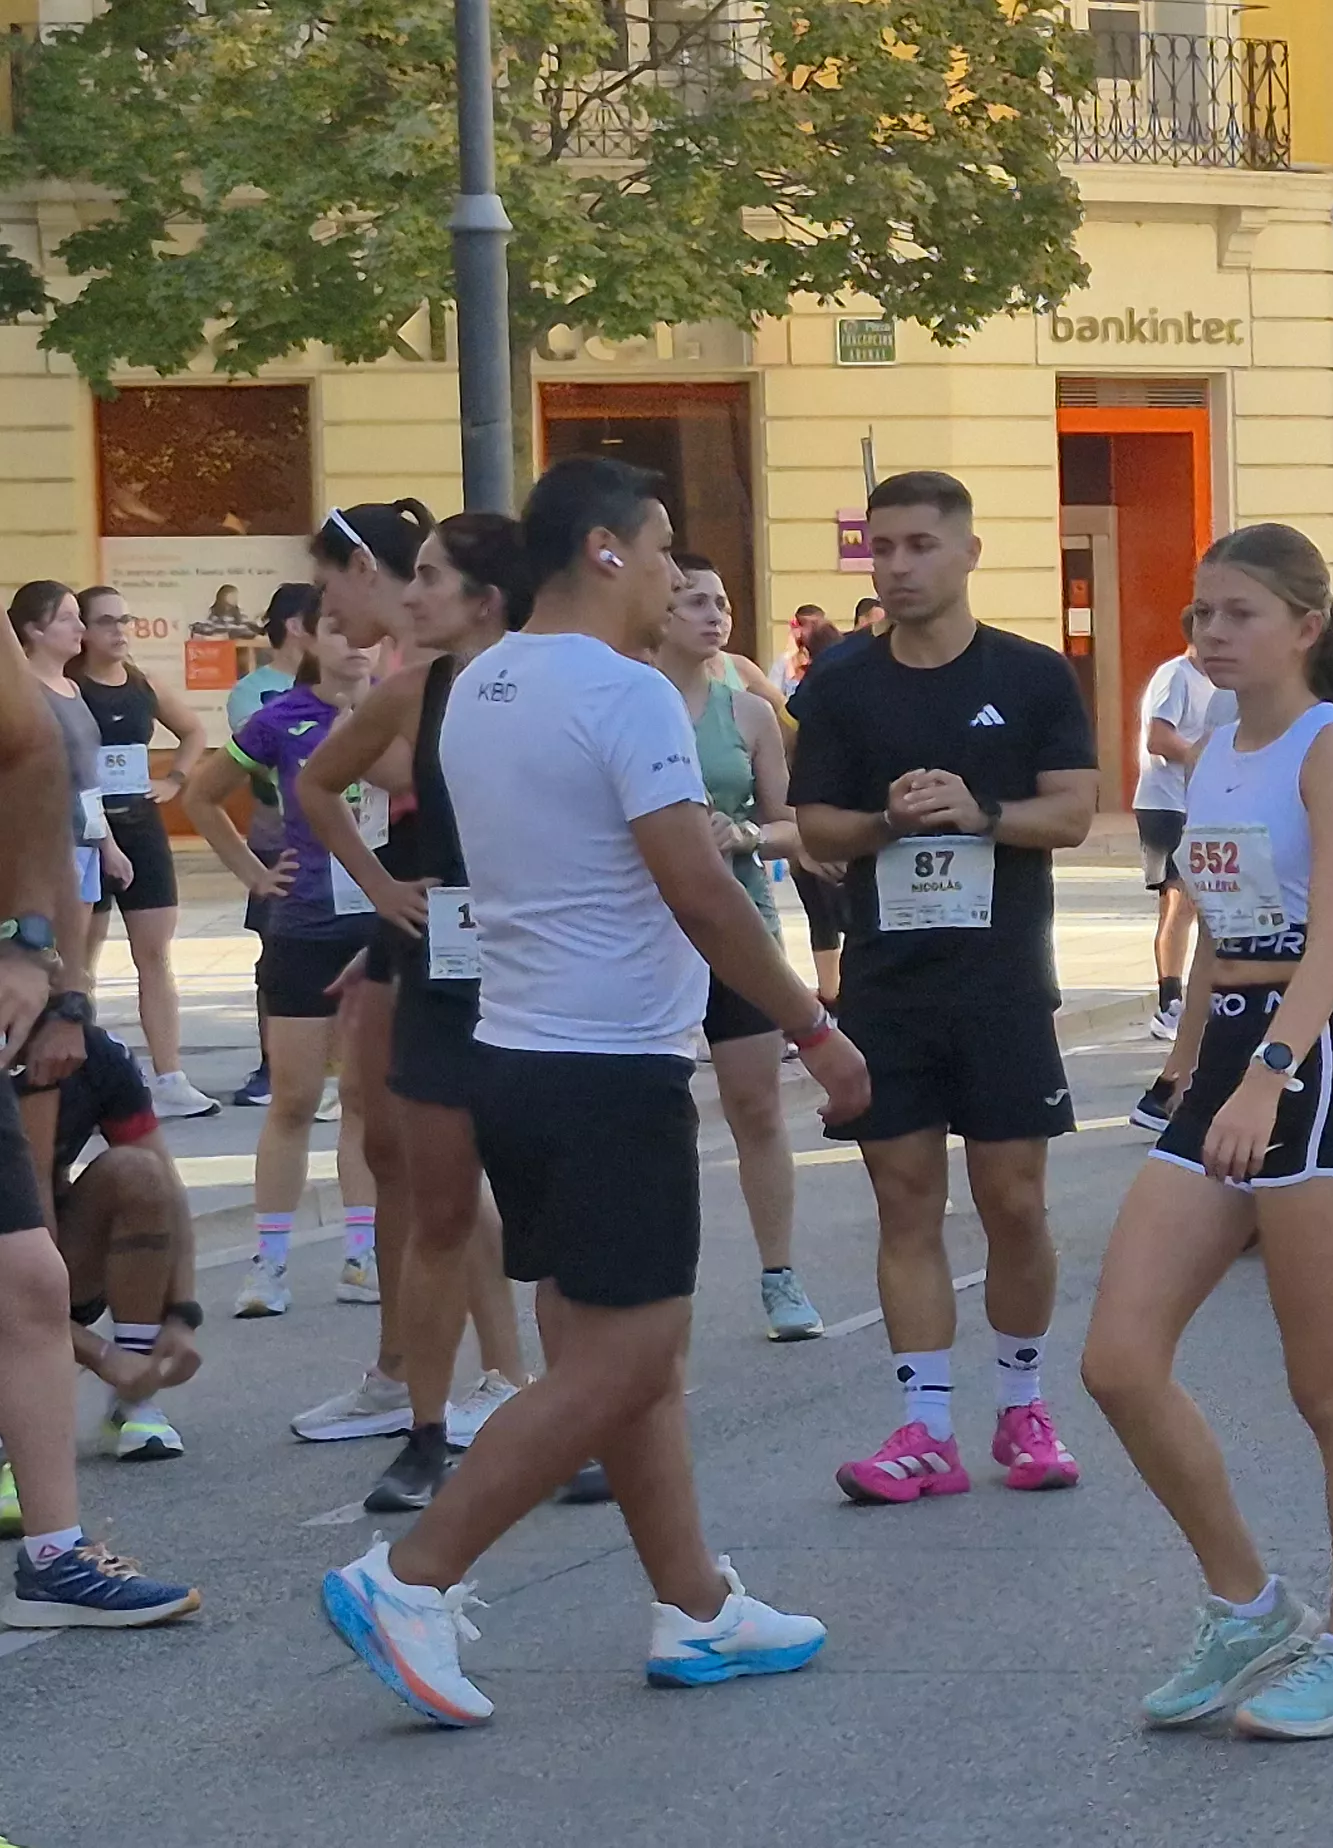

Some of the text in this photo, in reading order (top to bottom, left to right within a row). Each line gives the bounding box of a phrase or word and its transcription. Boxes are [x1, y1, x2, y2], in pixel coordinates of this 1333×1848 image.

[134, 617, 168, 639] 80
[915, 850, 954, 878] 87
[1189, 841, 1240, 874] 552
[457, 902, 477, 929] 1
